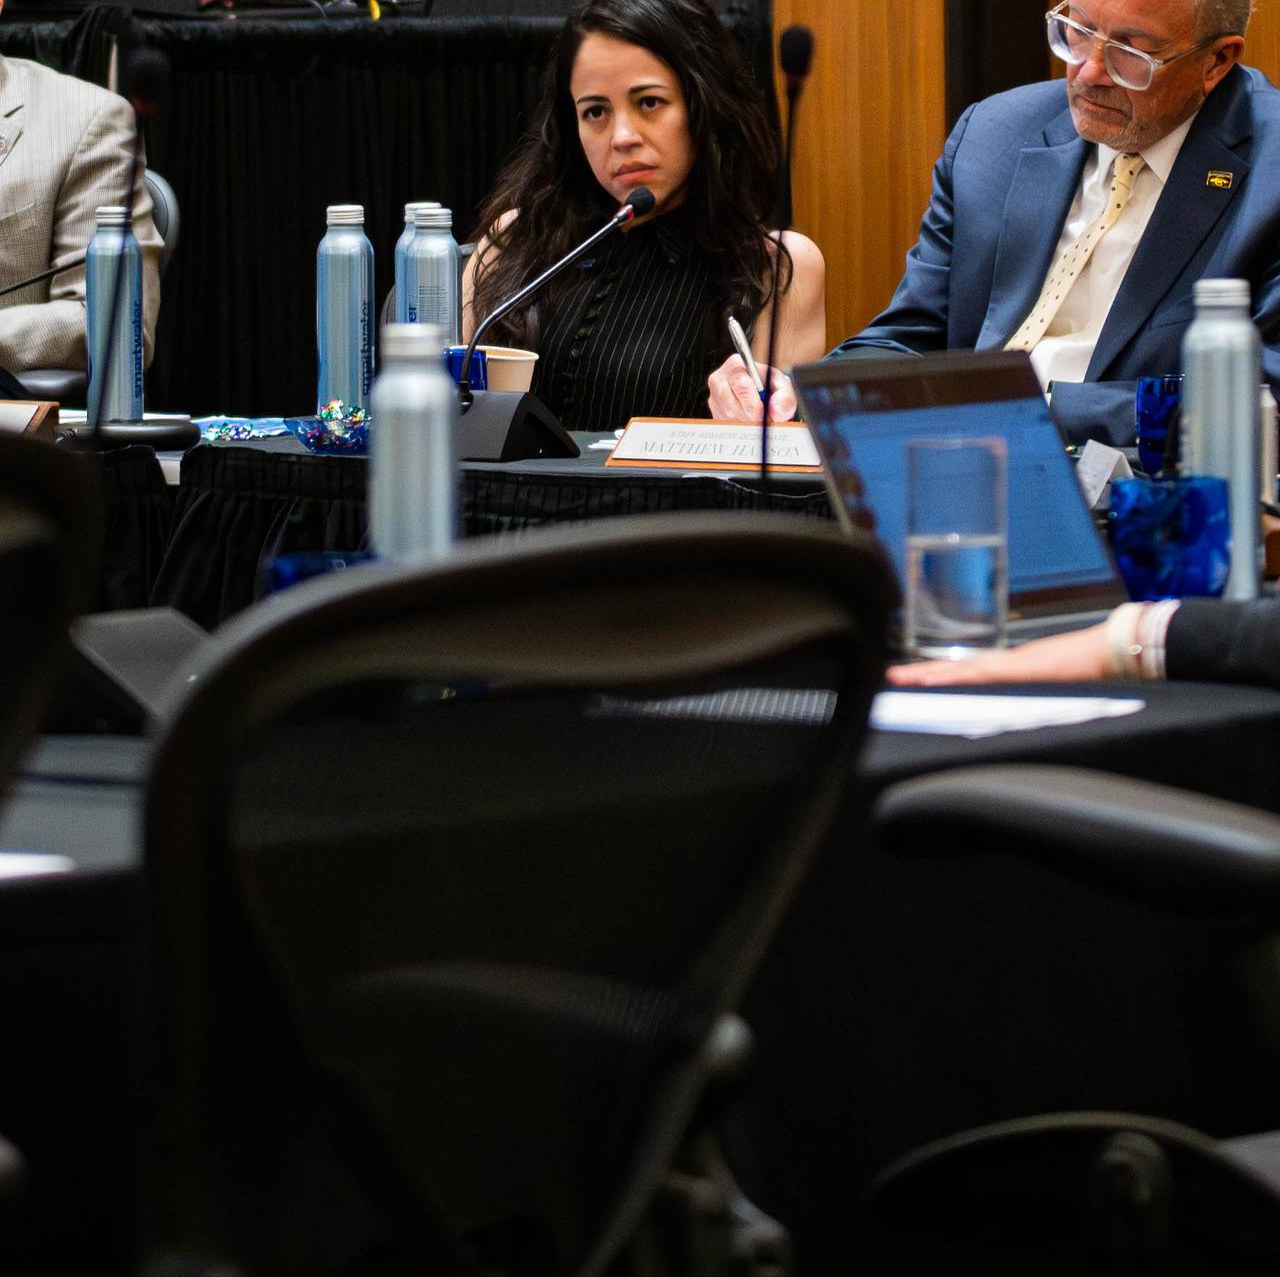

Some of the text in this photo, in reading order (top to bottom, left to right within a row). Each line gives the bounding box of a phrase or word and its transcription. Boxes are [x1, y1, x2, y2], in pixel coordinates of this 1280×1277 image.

[132, 300, 143, 398] smartwater
[640, 441, 805, 458] MATTHEW HASON
